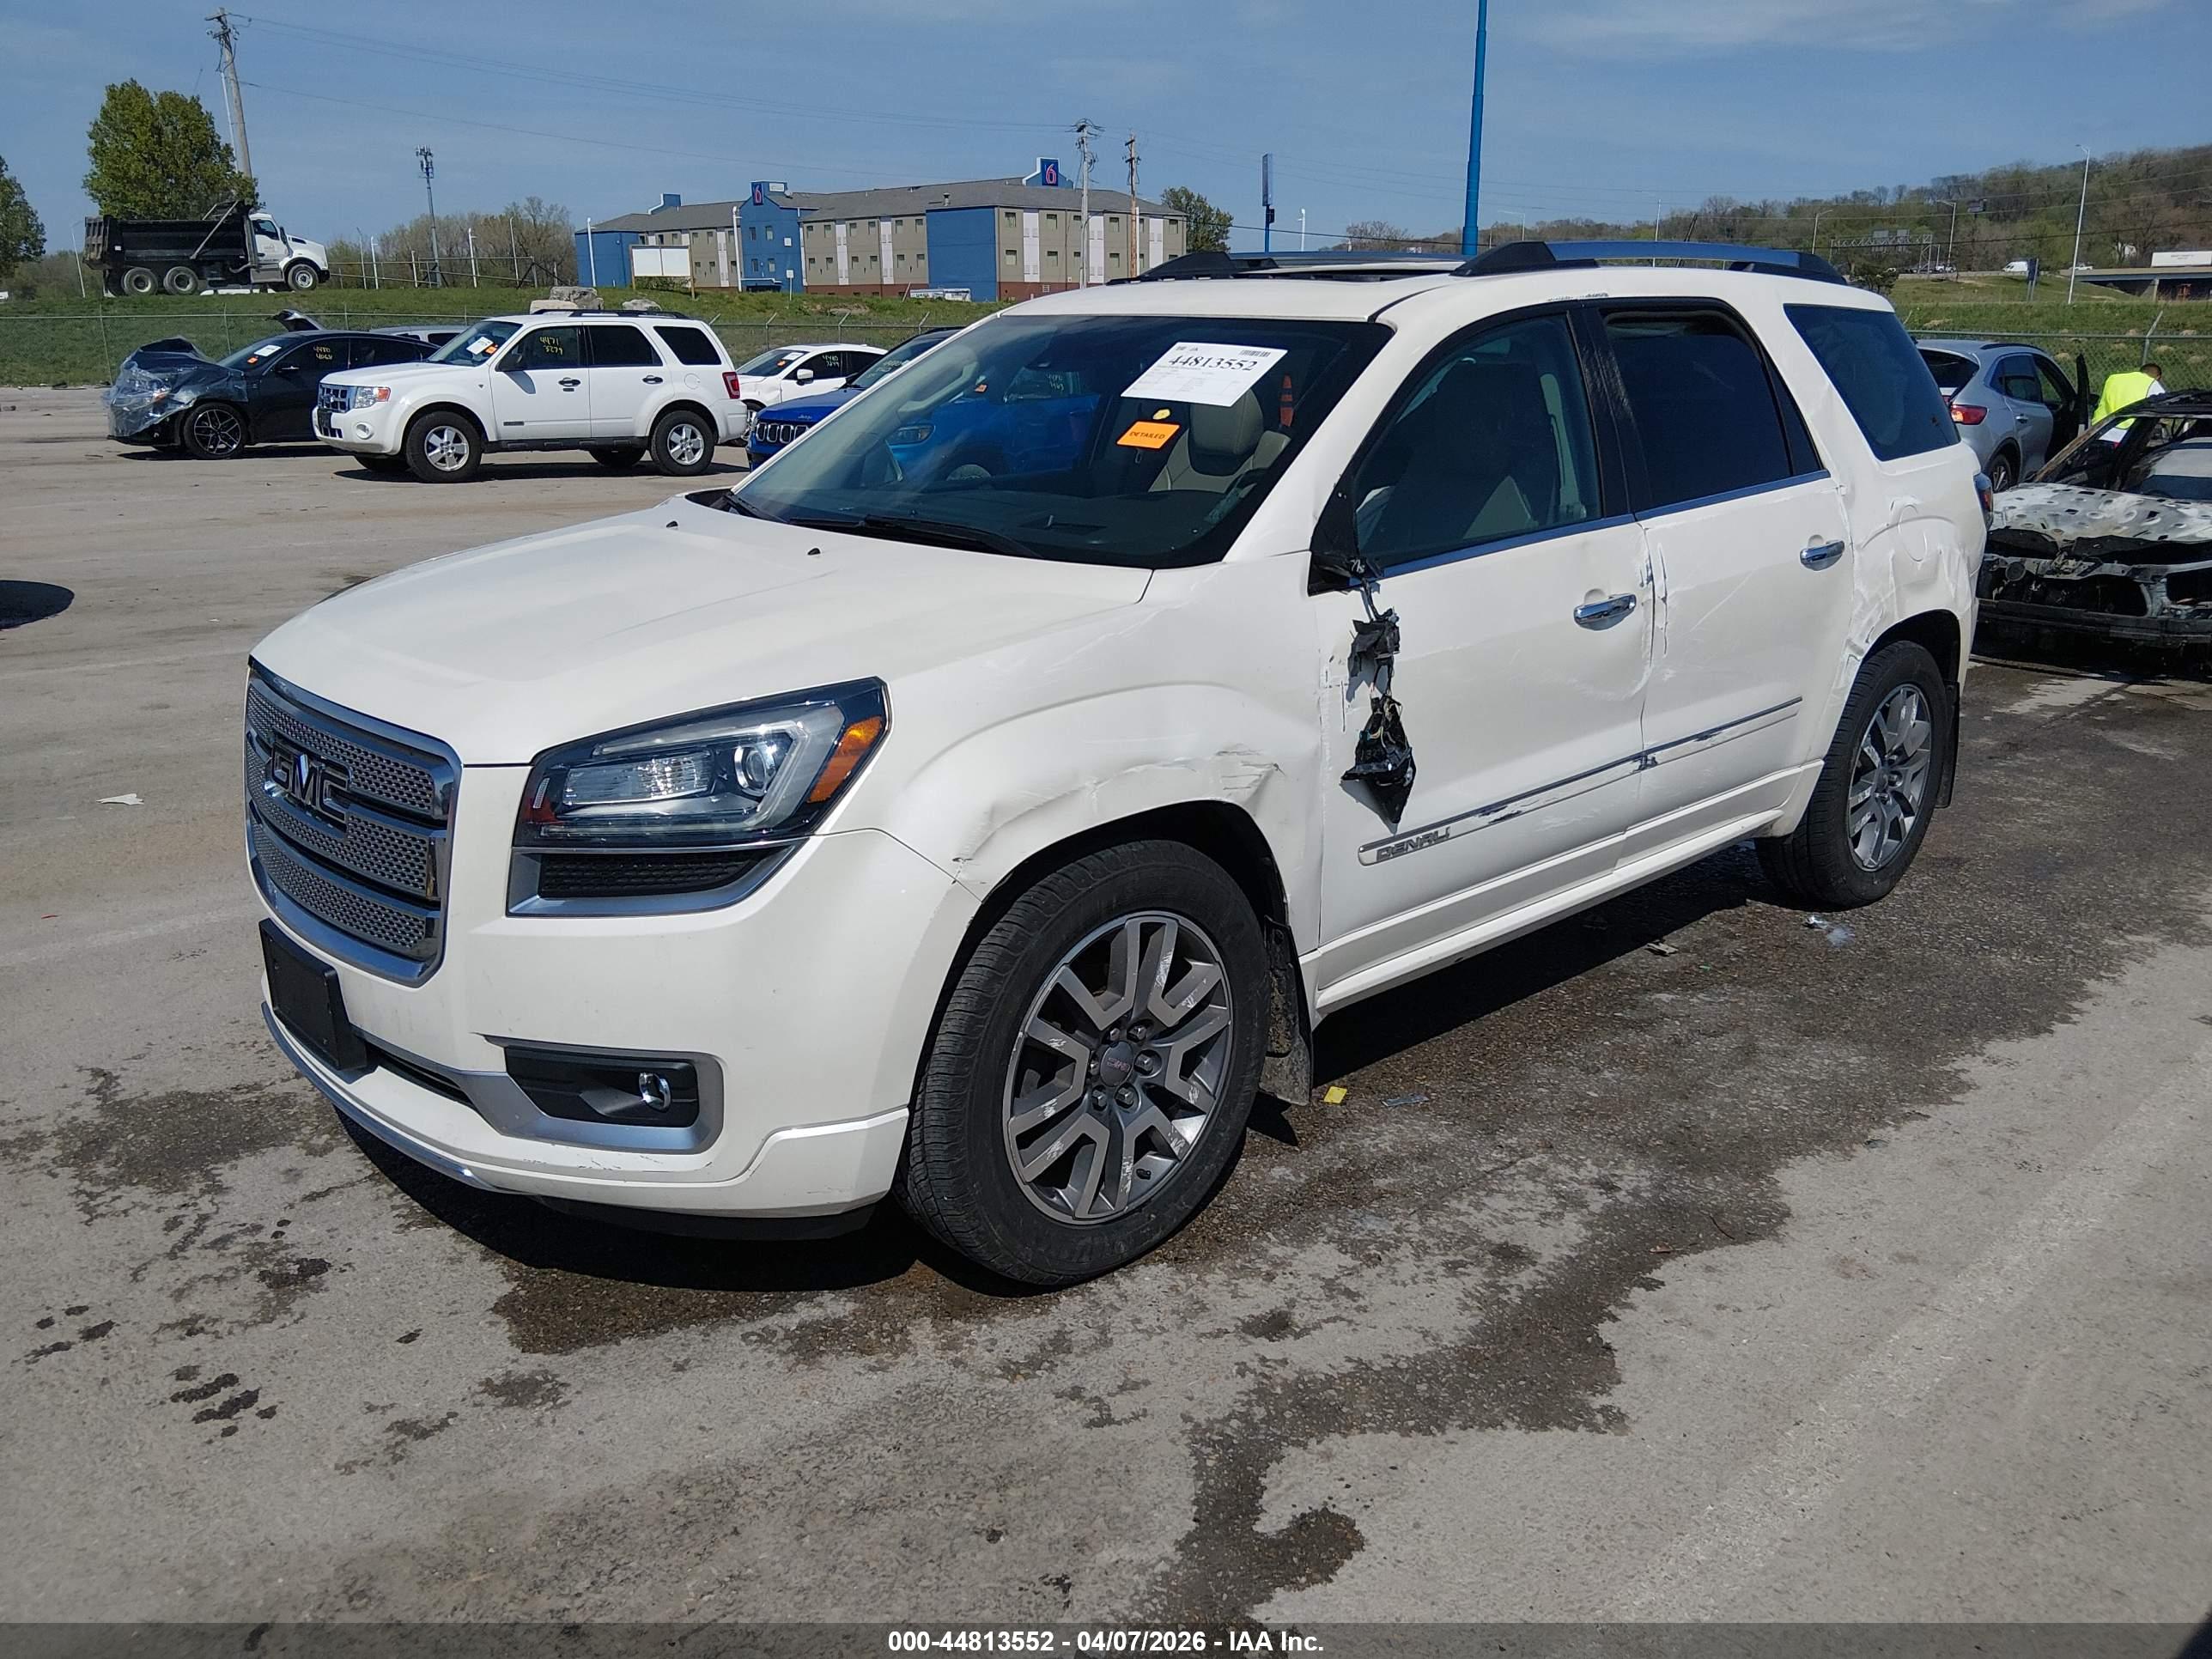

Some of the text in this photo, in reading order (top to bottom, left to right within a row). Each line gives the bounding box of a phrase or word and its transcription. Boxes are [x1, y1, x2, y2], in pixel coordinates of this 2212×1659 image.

[1046, 163, 1057, 185] 6
[755, 185, 762, 204] 6
[1168, 355, 1258, 371] 44813552
[1129, 430, 1166, 440] DETAILED
[271, 742, 348, 828] GMC
[1376, 826, 1451, 862] DENALI
